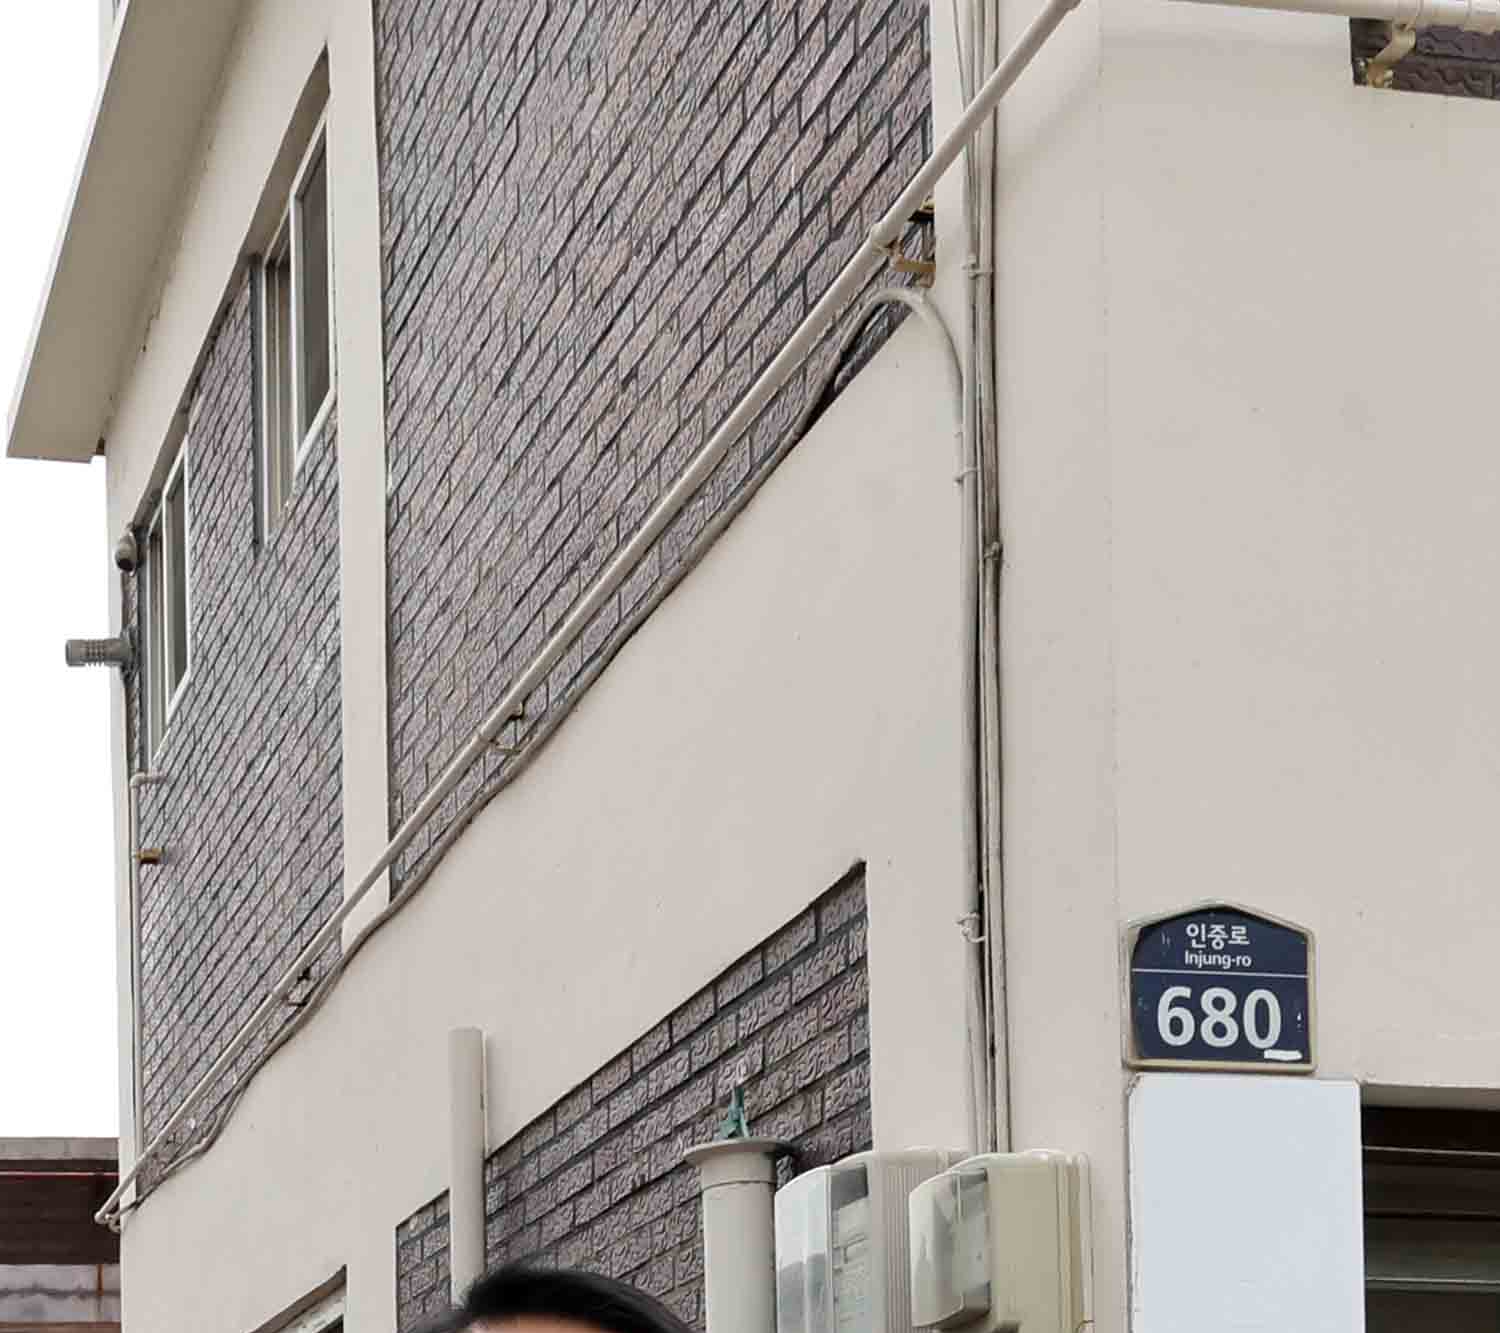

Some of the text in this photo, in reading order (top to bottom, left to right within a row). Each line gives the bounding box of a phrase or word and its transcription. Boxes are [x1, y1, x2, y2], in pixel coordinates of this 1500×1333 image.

[1186, 922, 1250, 950] 인중로
[1184, 950, 1252, 969] Injung-ro
[1157, 985, 1282, 1049] 680
